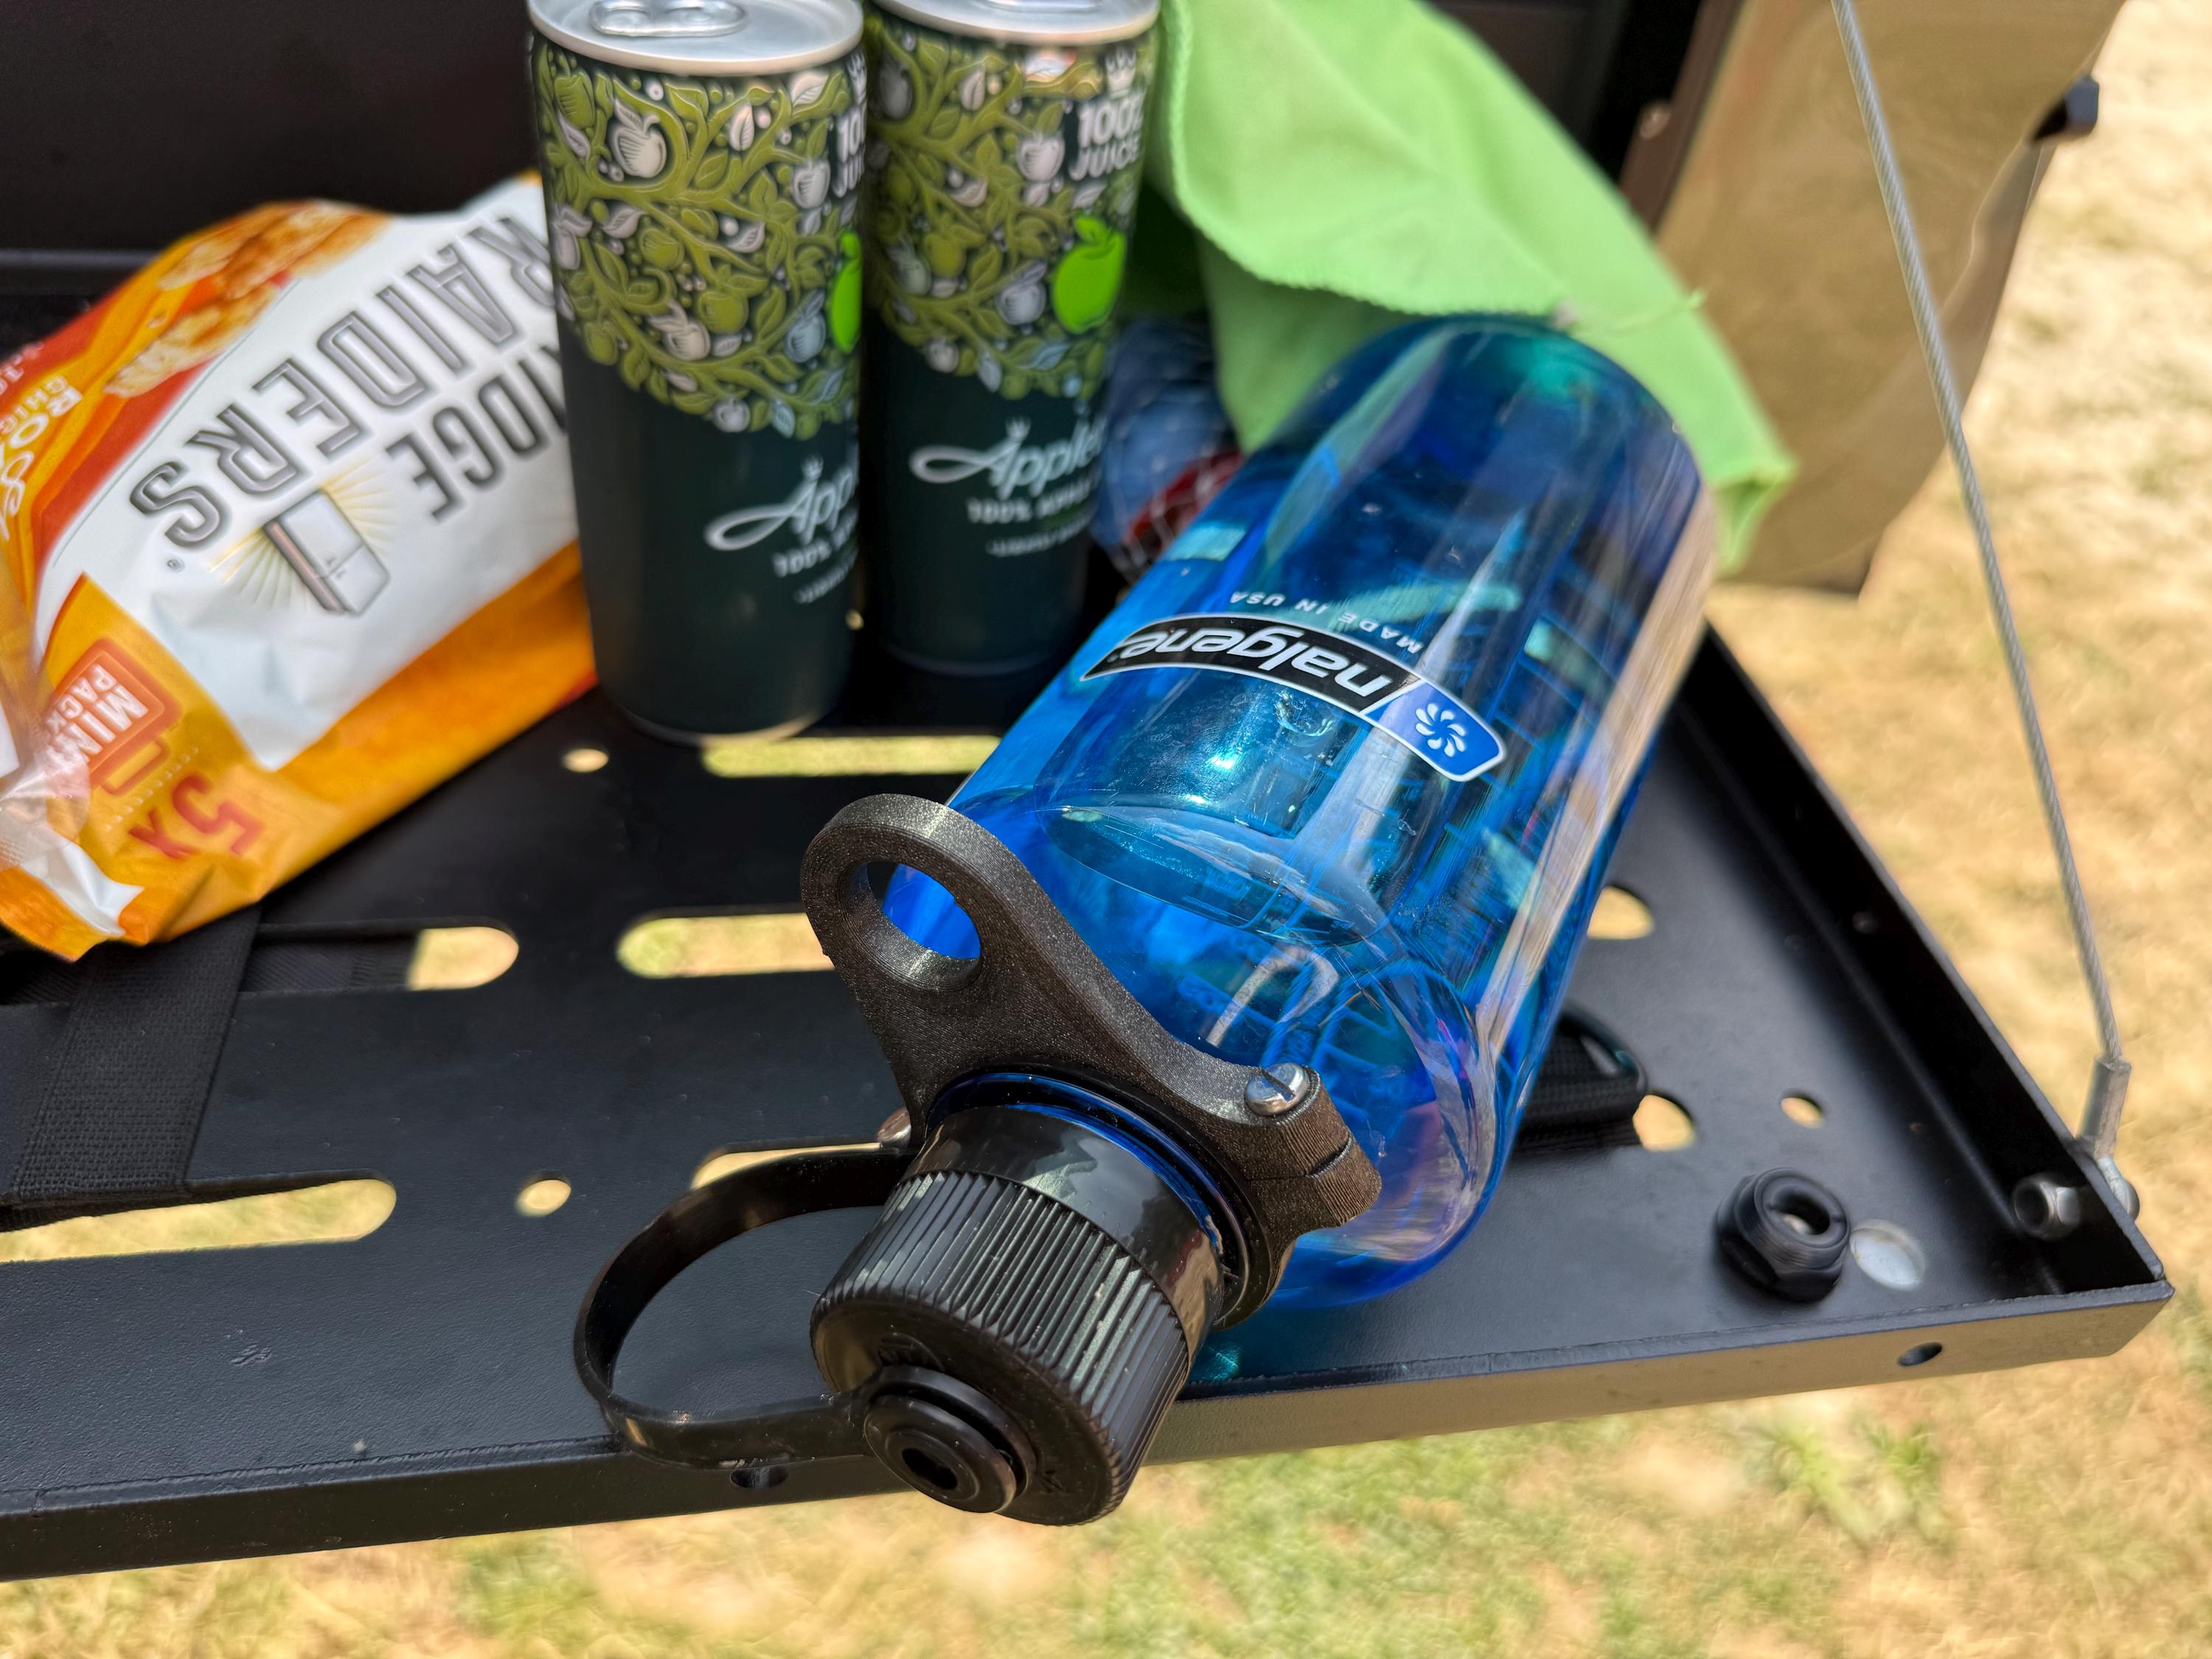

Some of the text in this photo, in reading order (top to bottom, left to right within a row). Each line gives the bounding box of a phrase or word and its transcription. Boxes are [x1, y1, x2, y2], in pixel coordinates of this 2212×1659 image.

[837, 101, 867, 163] 10
[128, 216, 555, 549] RAIDERS
[0, 384, 83, 467] RO
[386, 345, 566, 521] IDGE
[1229, 591, 1425, 655] MADE IN USA
[1117, 626, 1392, 698] nalgene
